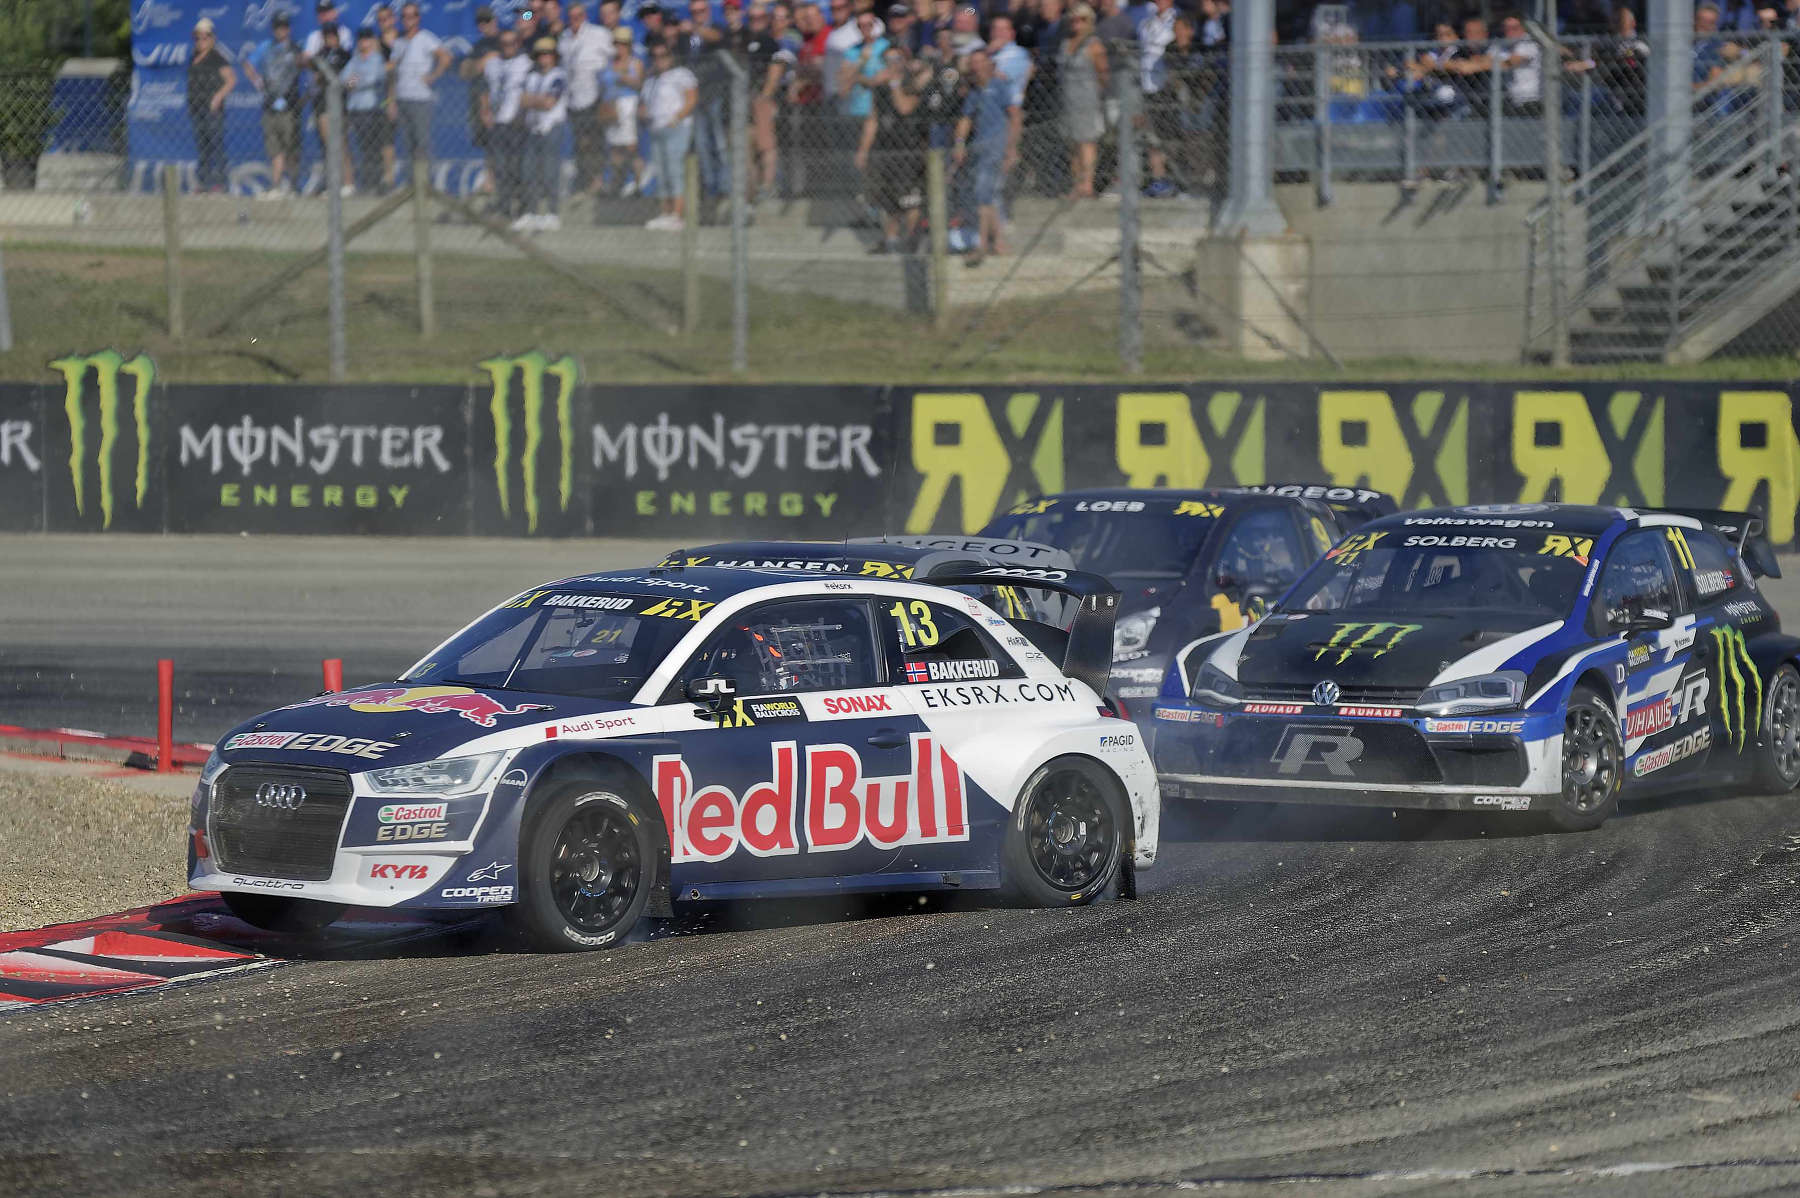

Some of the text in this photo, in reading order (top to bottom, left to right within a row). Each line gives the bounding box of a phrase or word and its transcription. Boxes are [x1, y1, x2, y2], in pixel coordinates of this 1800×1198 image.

[179, 414, 451, 475] MONSTER
[592, 412, 881, 480] MONSTER
[220, 483, 410, 508] ENERGY
[1225, 483, 1381, 503] UGEOT
[636, 490, 838, 517] ENERGY
[1074, 501, 1146, 512] LOEB
[1404, 516, 1555, 529] Volkswagen
[1404, 535, 1518, 549] SOLBERG
[1666, 527, 1697, 570] 11
[713, 559, 848, 573] HANSEN
[577, 575, 711, 593] Audi Sport
[542, 594, 634, 610] BAKKERUD
[889, 600, 939, 647] 13
[929, 659, 1000, 680] BAKKERUD
[921, 682, 1076, 708] EKSRX.COM
[755, 709, 800, 718] RALLYCROSS
[824, 695, 892, 715] SONAX
[1244, 704, 1303, 714] BAUHAUS
[1339, 707, 1402, 717] BAUHAUS
[562, 716, 636, 734] Audi Sport
[1436, 721, 1526, 732] Castrol EDGE
[1626, 698, 1673, 737] UHAUS
[236, 732, 400, 759] Castrol EDGE
[1108, 735, 1134, 746] PAGID
[1643, 727, 1711, 773] Castrol EDGE
[653, 740, 800, 864] Red
[805, 732, 970, 853] Bull
[393, 804, 443, 821] Castrol
[376, 822, 449, 841] EDGE
[371, 863, 429, 880] KYB
[233, 877, 304, 890] quattro
[442, 886, 514, 897] COOPER
[476, 895, 512, 903] TIRES
[562, 926, 616, 946] COOPER
